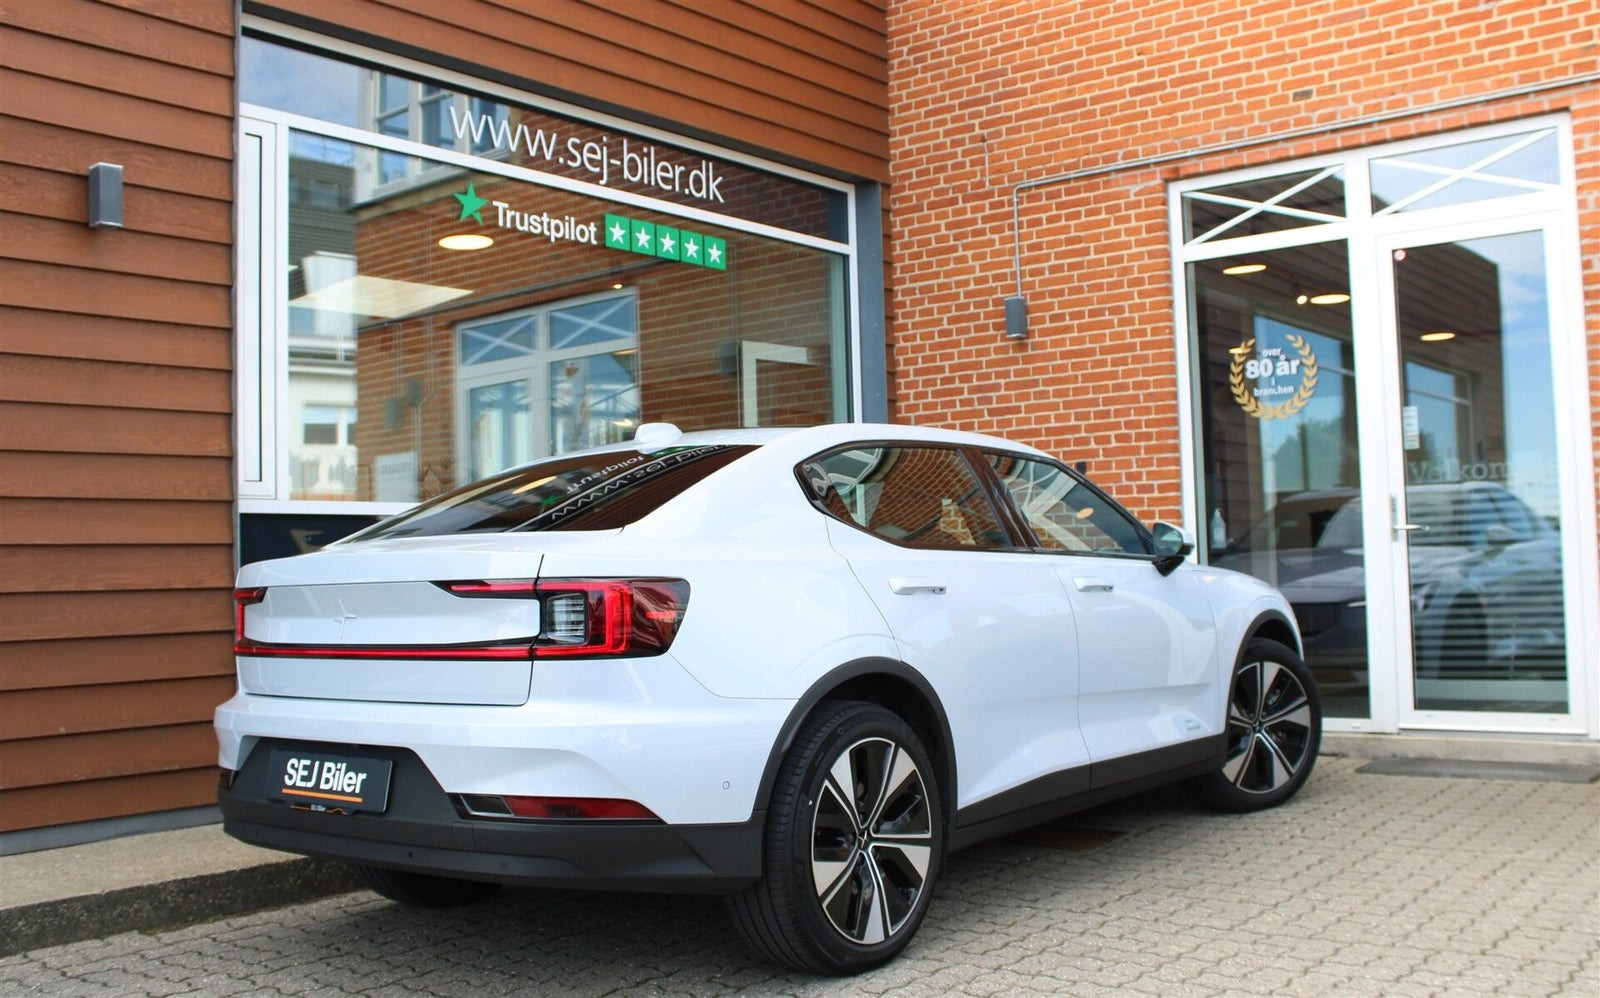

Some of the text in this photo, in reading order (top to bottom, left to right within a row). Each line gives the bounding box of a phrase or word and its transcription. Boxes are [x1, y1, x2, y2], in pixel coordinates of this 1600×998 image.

[449, 106, 725, 203] www.sej-biler.dk
[492, 201, 598, 245] Trustpilot
[1245, 354, 1300, 379] 80 år
[1262, 348, 1282, 357] over
[284, 758, 368, 794] SEJ Biler
